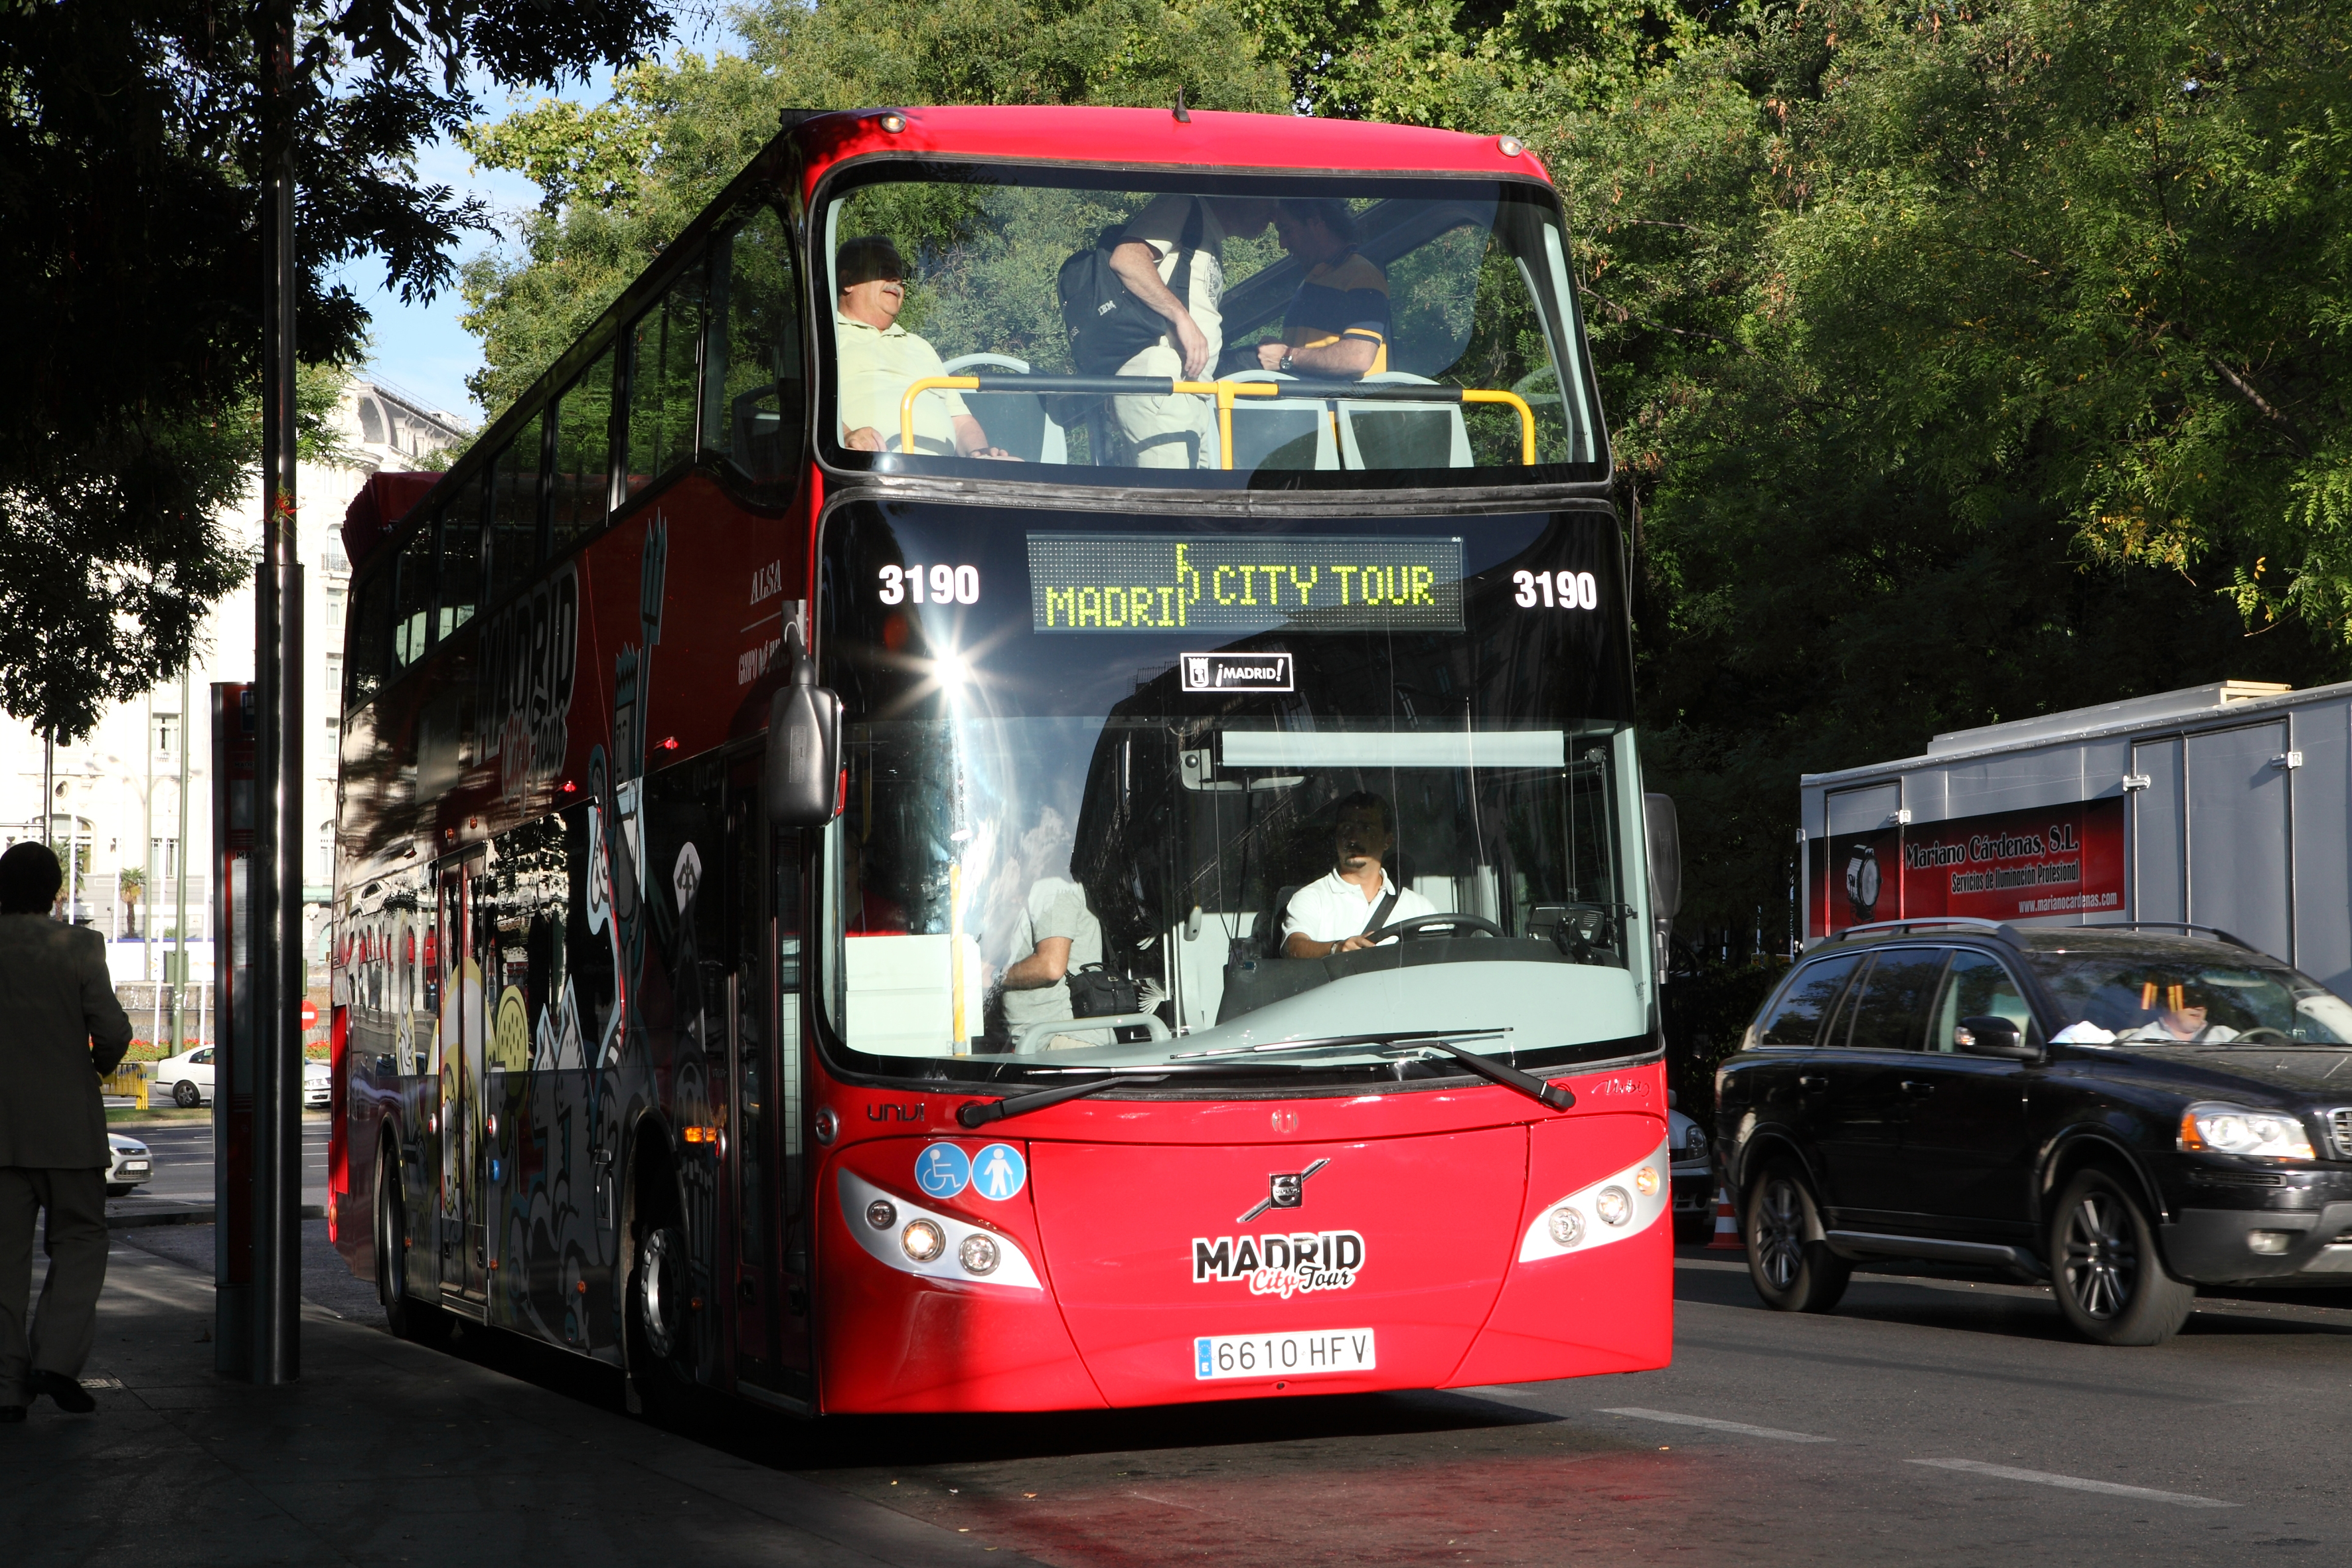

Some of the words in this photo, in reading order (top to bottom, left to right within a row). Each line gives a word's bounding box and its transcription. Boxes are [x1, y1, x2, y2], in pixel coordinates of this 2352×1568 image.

[1097, 300, 1117, 316] IBM
[749, 560, 781, 605] ALSA
[879, 565, 979, 605] 3190
[1214, 565, 1317, 605] CITY
[1331, 565, 1434, 605] TOUR
[1513, 570, 1597, 610] 3190
[473, 560, 579, 768] MADRID
[738, 648, 758, 685] GRUPO
[1907, 841, 1966, 869] Mariano
[1970, 833, 2045, 860] Cárdenas,
[2049, 824, 2078, 852] S.L.
[1952, 870, 1984, 893] Servicios
[1986, 870, 1994, 890] de
[1996, 864, 2035, 889] Iluminación
[2038, 860, 2078, 884] Profesional
[2019, 892, 2117, 913] www.marianocardenas.com
[1196, 1235, 1362, 1279] MADRID
[1253, 1269, 1298, 1295] City
[1299, 1265, 1352, 1290] Tour
[1202, 1362, 1210, 1373] E
[1218, 1339, 1298, 1372] 6610
[1310, 1335, 1366, 1367] HFV
